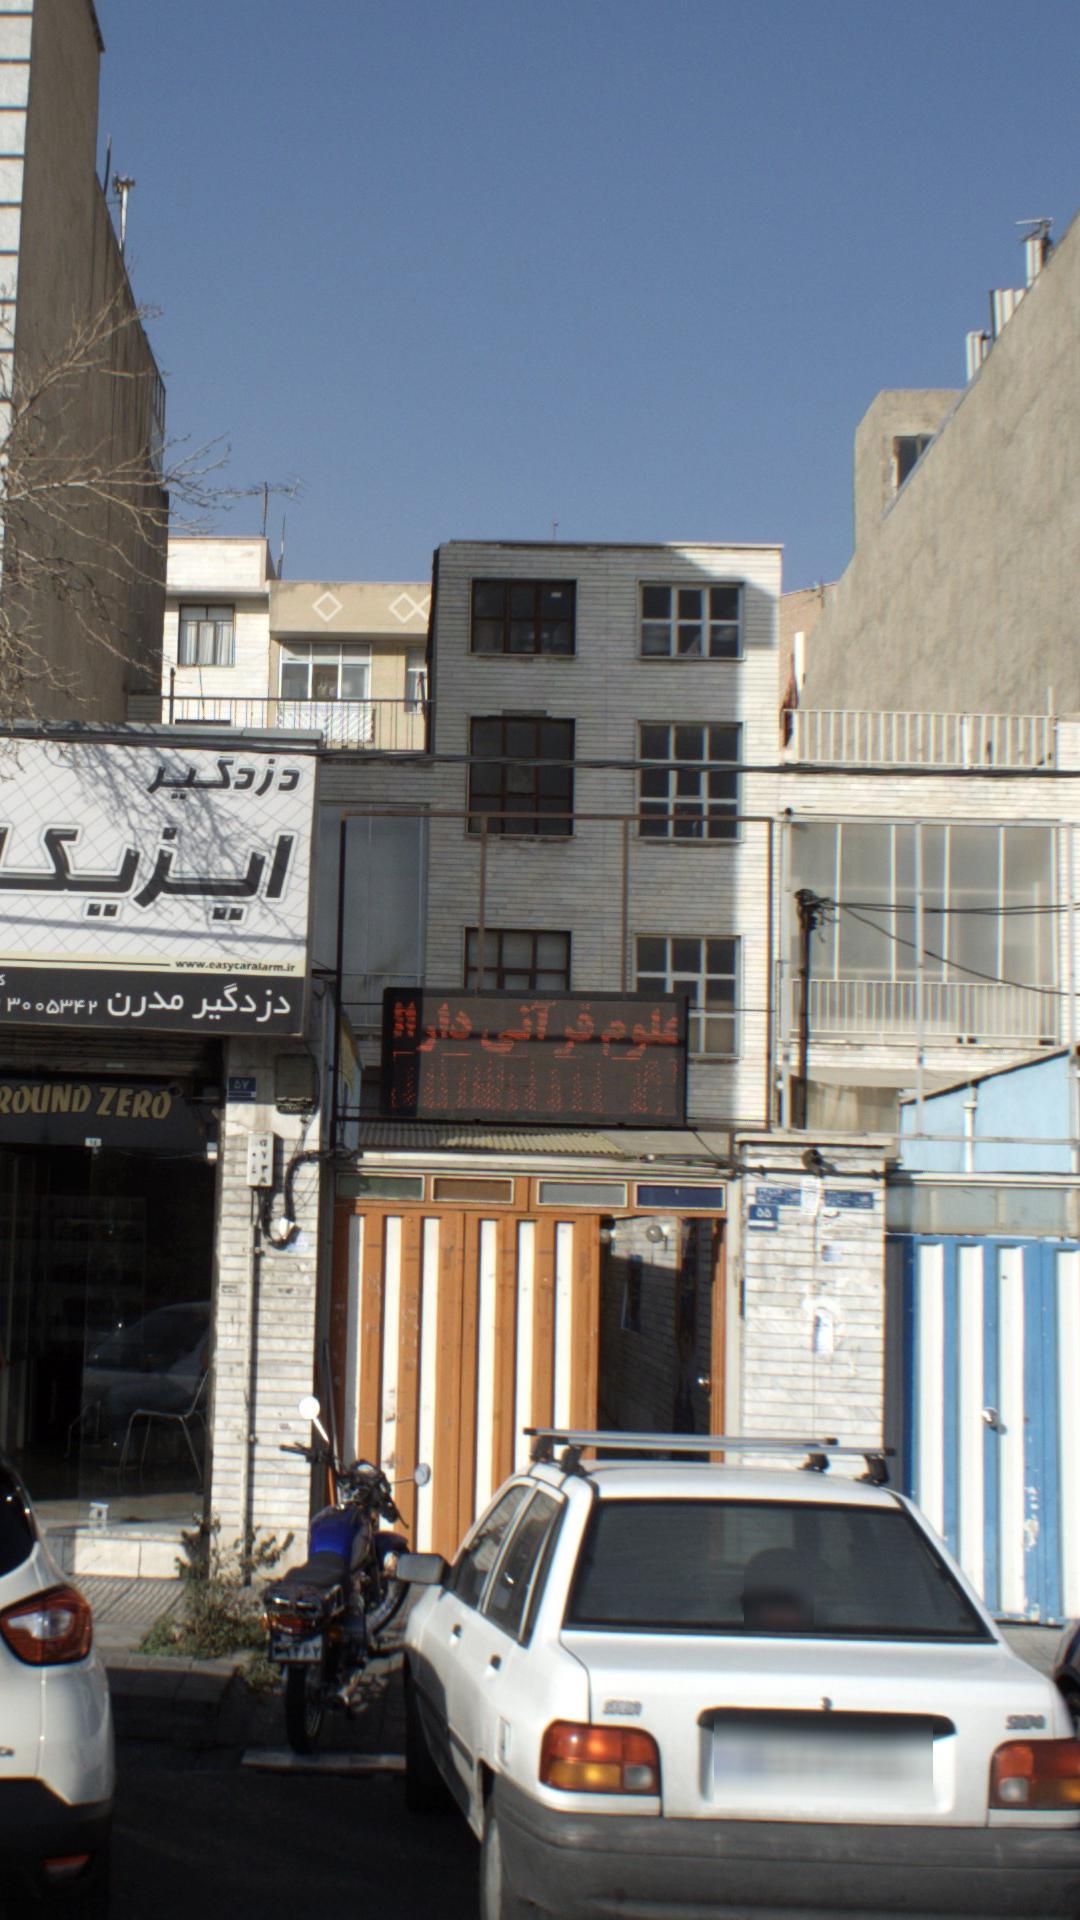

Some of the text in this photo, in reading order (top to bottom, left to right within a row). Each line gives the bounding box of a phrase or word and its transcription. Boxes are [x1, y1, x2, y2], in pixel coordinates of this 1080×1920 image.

[175, 960, 296, 972] www.easycaralarm.ir
[107, 988, 184, 1016] مدرن
[192, 983, 291, 1022] دزدگیر
[96, 1086, 172, 1119] ZERO
